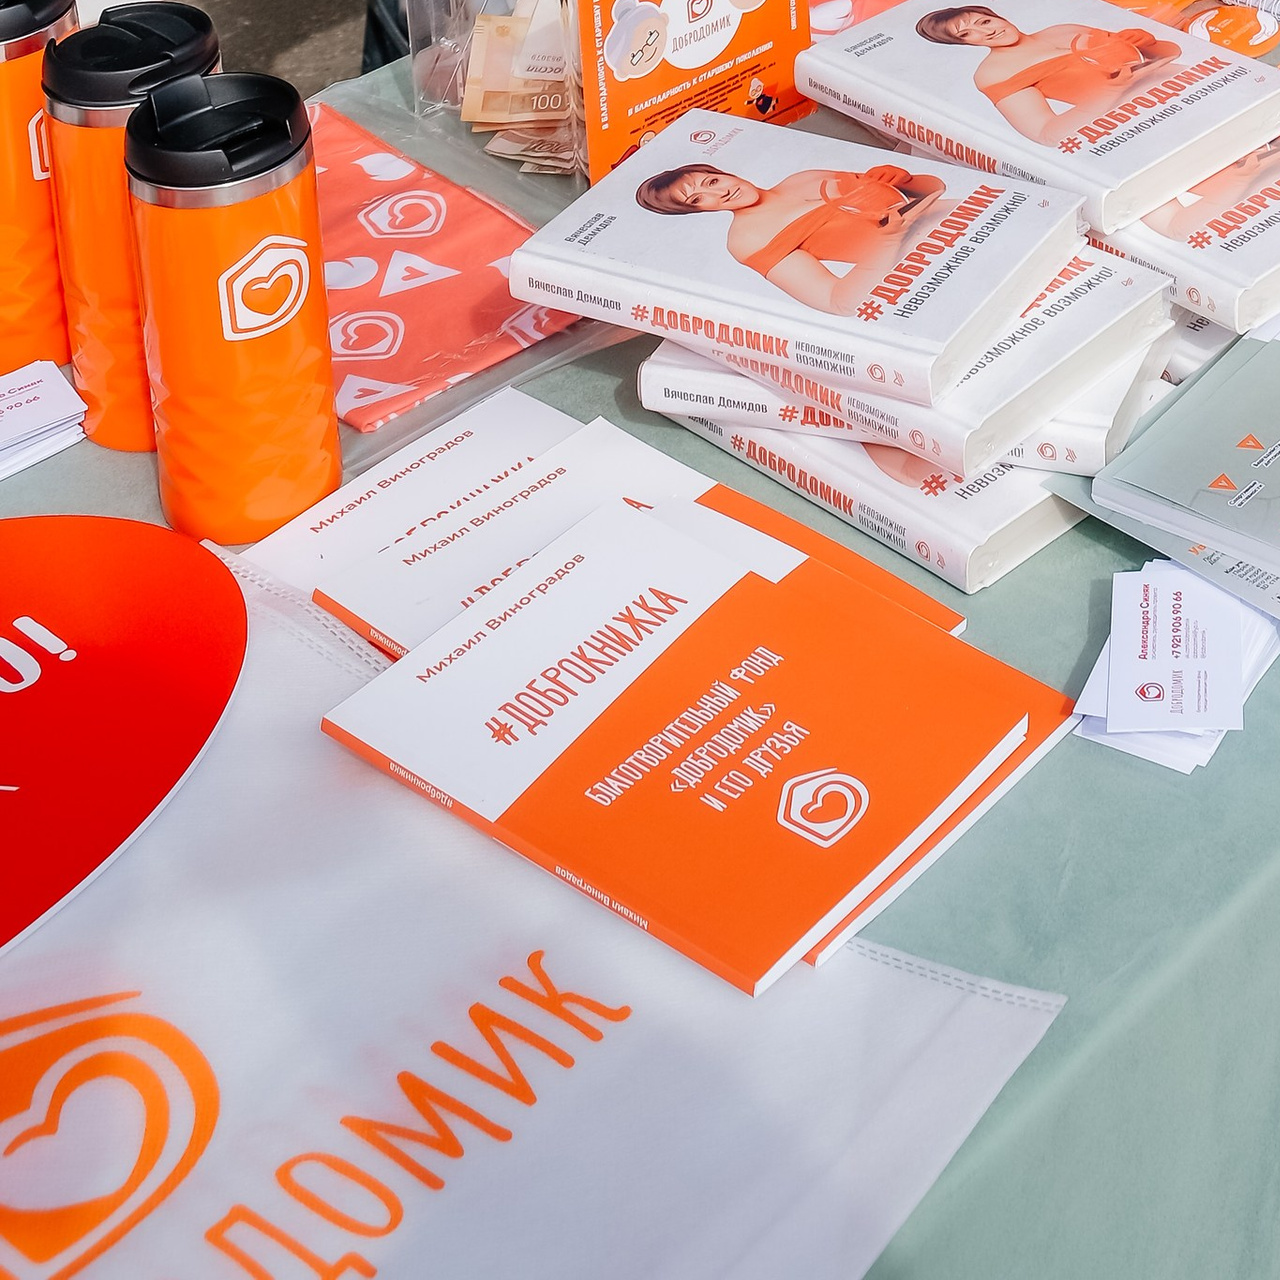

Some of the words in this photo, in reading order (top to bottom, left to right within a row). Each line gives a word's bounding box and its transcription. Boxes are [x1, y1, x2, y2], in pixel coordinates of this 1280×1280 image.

[593, 3, 603, 47] СТАРШЕМУ
[671, 13, 732, 55] ДОБРОДОМИК
[531, 94, 562, 110] 100
[597, 56, 608, 121] БЛАГОДАРНОСТЬ
[636, 83, 692, 115] БЛАГОДАРНОСТЬ
[698, 64, 735, 88] СТАРШЕМУ
[1057, 54, 1234, 158] #ДОБРОДОМИК
[1089, 102, 1183, 159] Невозможное
[1181, 65, 1253, 108] возможно!
[807, 76, 843, 105] Вячеслав
[841, 92, 876, 119] Демидов
[880, 110, 999, 178] #ДОБРОДОМИК
[565, 210, 605, 244] Вячеслав
[576, 214, 617, 248] Демидов
[856, 183, 1007, 324] #ДОБРОДОМИК
[897, 239, 976, 320] Невозможное
[970, 190, 1030, 258] возможно!
[528, 276, 576, 303] Вячеслав
[573, 287, 622, 313] Демидов
[630, 303, 791, 361] #ДОБРОДОМИК
[794, 340, 857, 363] НЕВОЗМОЖНОЕ
[1043, 265, 1119, 326] возможно!
[795, 352, 857, 378] ВОЗМОЖНО!
[663, 386, 715, 413] Вячеслав
[712, 391, 768, 416] Демидов
[847, 395, 900, 427] НЕВОЗМОЖНОЕ
[848, 408, 900, 441] ВОЗМОЖНО!
[309, 488, 372, 535] Михаил
[371, 426, 475, 497] Виноградов
[730, 434, 856, 517] #ДОБРОДОМИК
[857, 501, 908, 539] НЕВОЗМОЖНОЕ
[401, 523, 467, 567] Михаил
[462, 463, 569, 531] Виноградов
[857, 515, 908, 552] ВОЗМОЖНО!
[415, 634, 488, 685] Михаил
[486, 551, 586, 635] Виноградов
[1139, 583, 1150, 608] Синяк
[1171, 590, 1182, 601] 66
[1171, 603, 1182, 614] 90
[1137, 609, 1151, 659] Александра
[1171, 615, 1182, 632] 906
[1171, 634, 1181, 648] 921
[482, 585, 690, 747] #ДОБРОКНИЖКА
[1171, 650, 1181, 658] +7
[1169, 669, 1186, 714] ДОБРОДОМИК
[584, 679, 742, 807] БЛАГОТВОРИТЕЛЬНЫЙ
[729, 645, 785, 684] ФОНД
[670, 702, 777, 793] «ДОБРОДОМИК»
[388, 760, 455, 809] #Доброкнижка
[699, 792, 728, 813] И
[714, 769, 754, 800] ЕГО
[742, 720, 811, 779] ДРУЗЬЯ
[554, 862, 610, 909] Виноградов
[603, 893, 650, 931] Михаил
